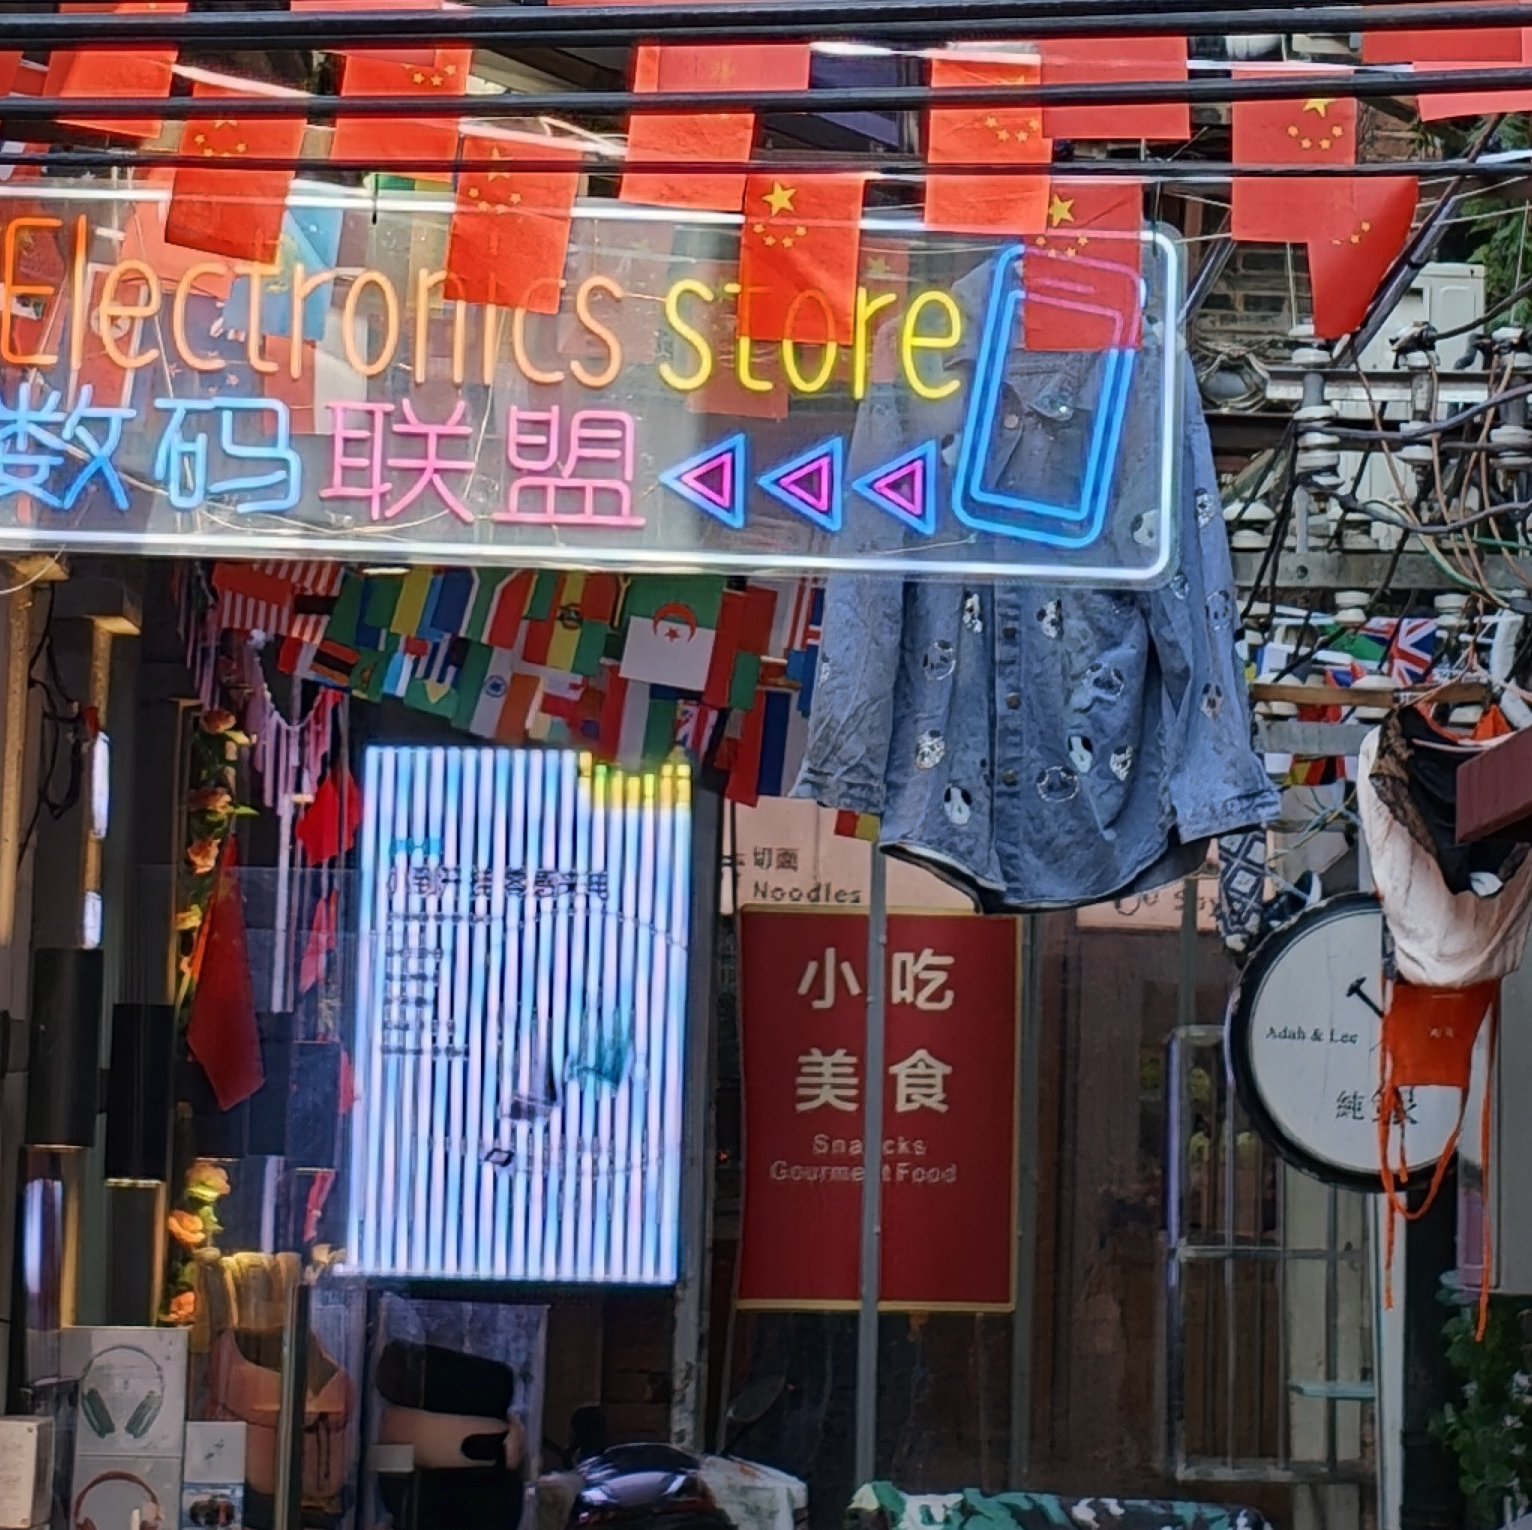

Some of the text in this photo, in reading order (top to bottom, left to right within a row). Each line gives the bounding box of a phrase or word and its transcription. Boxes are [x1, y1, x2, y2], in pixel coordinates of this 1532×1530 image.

[751, 881, 863, 904] Noodles
[796, 944, 956, 1011] 小吃
[1329, 1027, 1359, 1044] Lee
[794, 1046, 954, 1114] 美食
[812, 1132, 928, 1156] Snacks
[769, 1160, 959, 1185] Gourmet Food
